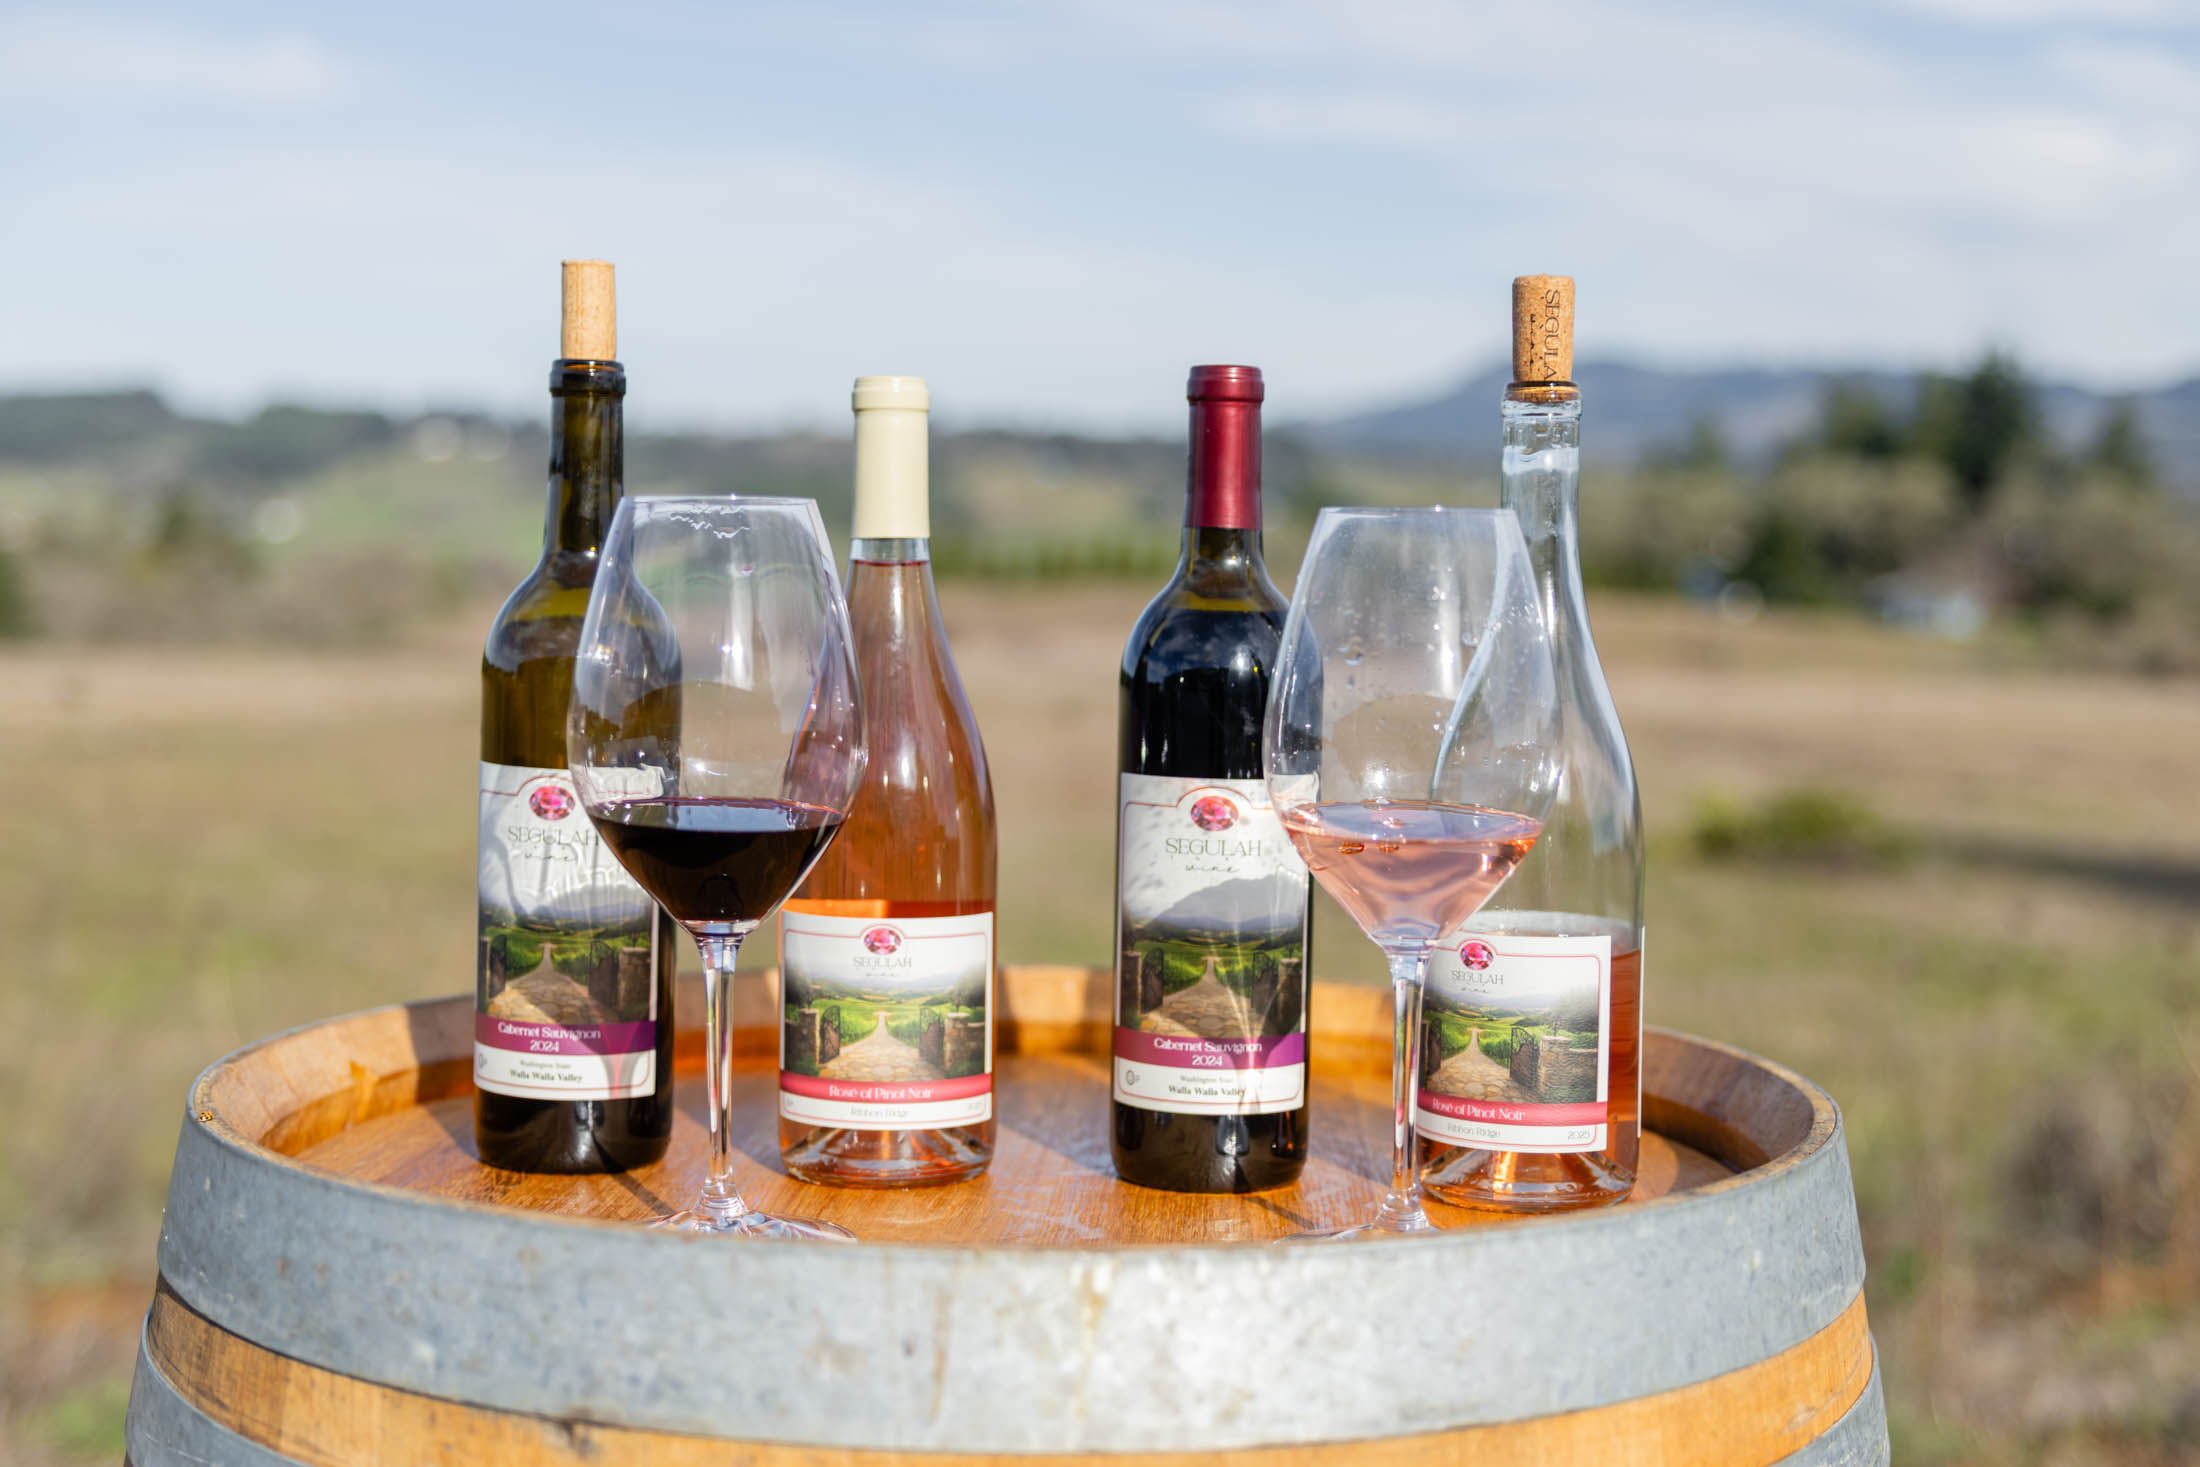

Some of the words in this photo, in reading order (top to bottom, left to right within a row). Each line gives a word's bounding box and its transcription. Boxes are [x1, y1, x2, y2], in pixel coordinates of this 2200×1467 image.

[1544, 289, 1560, 380] SEGULA
[507, 825, 599, 847] SEGULAH
[1165, 837, 1262, 857] SEGULAH
[1450, 969, 1504, 985] SEGULAH
[497, 1021, 540, 1037] Cabernet
[542, 1025, 601, 1042] Sauvignon
[529, 1039, 561, 1053] 2024
[1153, 1036, 1203, 1052] Cabernet
[1204, 1041, 1263, 1056] Sauvignon
[1191, 1054, 1224, 1067] 2024
[509, 1068, 530, 1080] Walla
[532, 1071, 555, 1082] Walla
[557, 1073, 583, 1083] Valley
[859, 1086, 873, 1099] of
[874, 1087, 907, 1100] Pinot
[908, 1086, 933, 1099] Noir
[1168, 1084, 1192, 1095] Walla
[1194, 1086, 1219, 1097] Walla
[1220, 1087, 1247, 1098] Valley
[1454, 1103, 1466, 1115] of
[1467, 1105, 1497, 1120] Pinot
[1499, 1107, 1527, 1121] Noir
[1567, 1129, 1591, 1140] 2025
